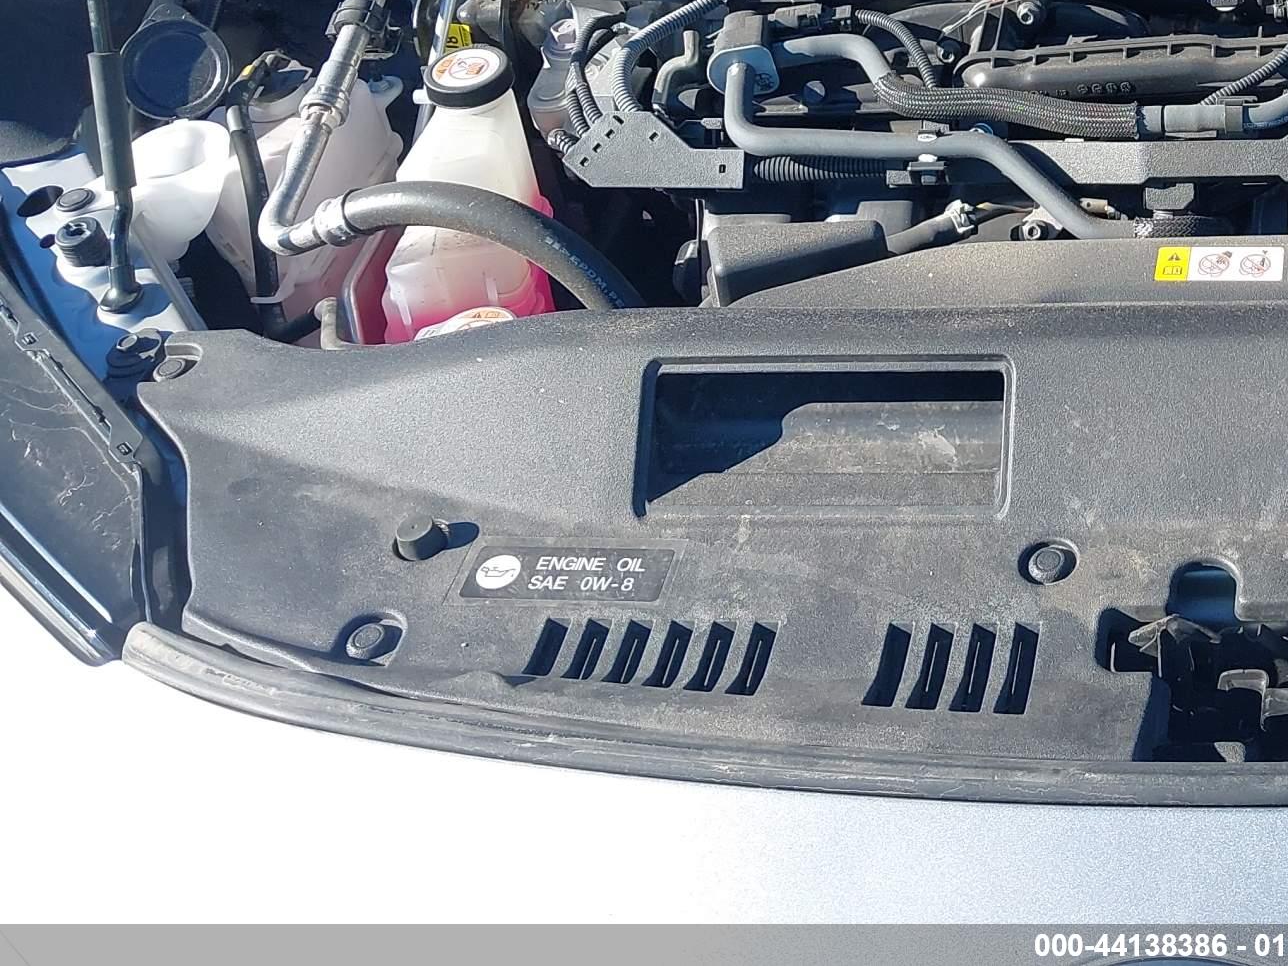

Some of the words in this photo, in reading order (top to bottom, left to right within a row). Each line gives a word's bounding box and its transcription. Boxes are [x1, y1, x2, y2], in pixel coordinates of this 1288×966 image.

[536, 556, 606, 571] ENGINE
[616, 557, 646, 572] OIL
[528, 575, 569, 591] SAE
[580, 576, 634, 591] 0W-8
